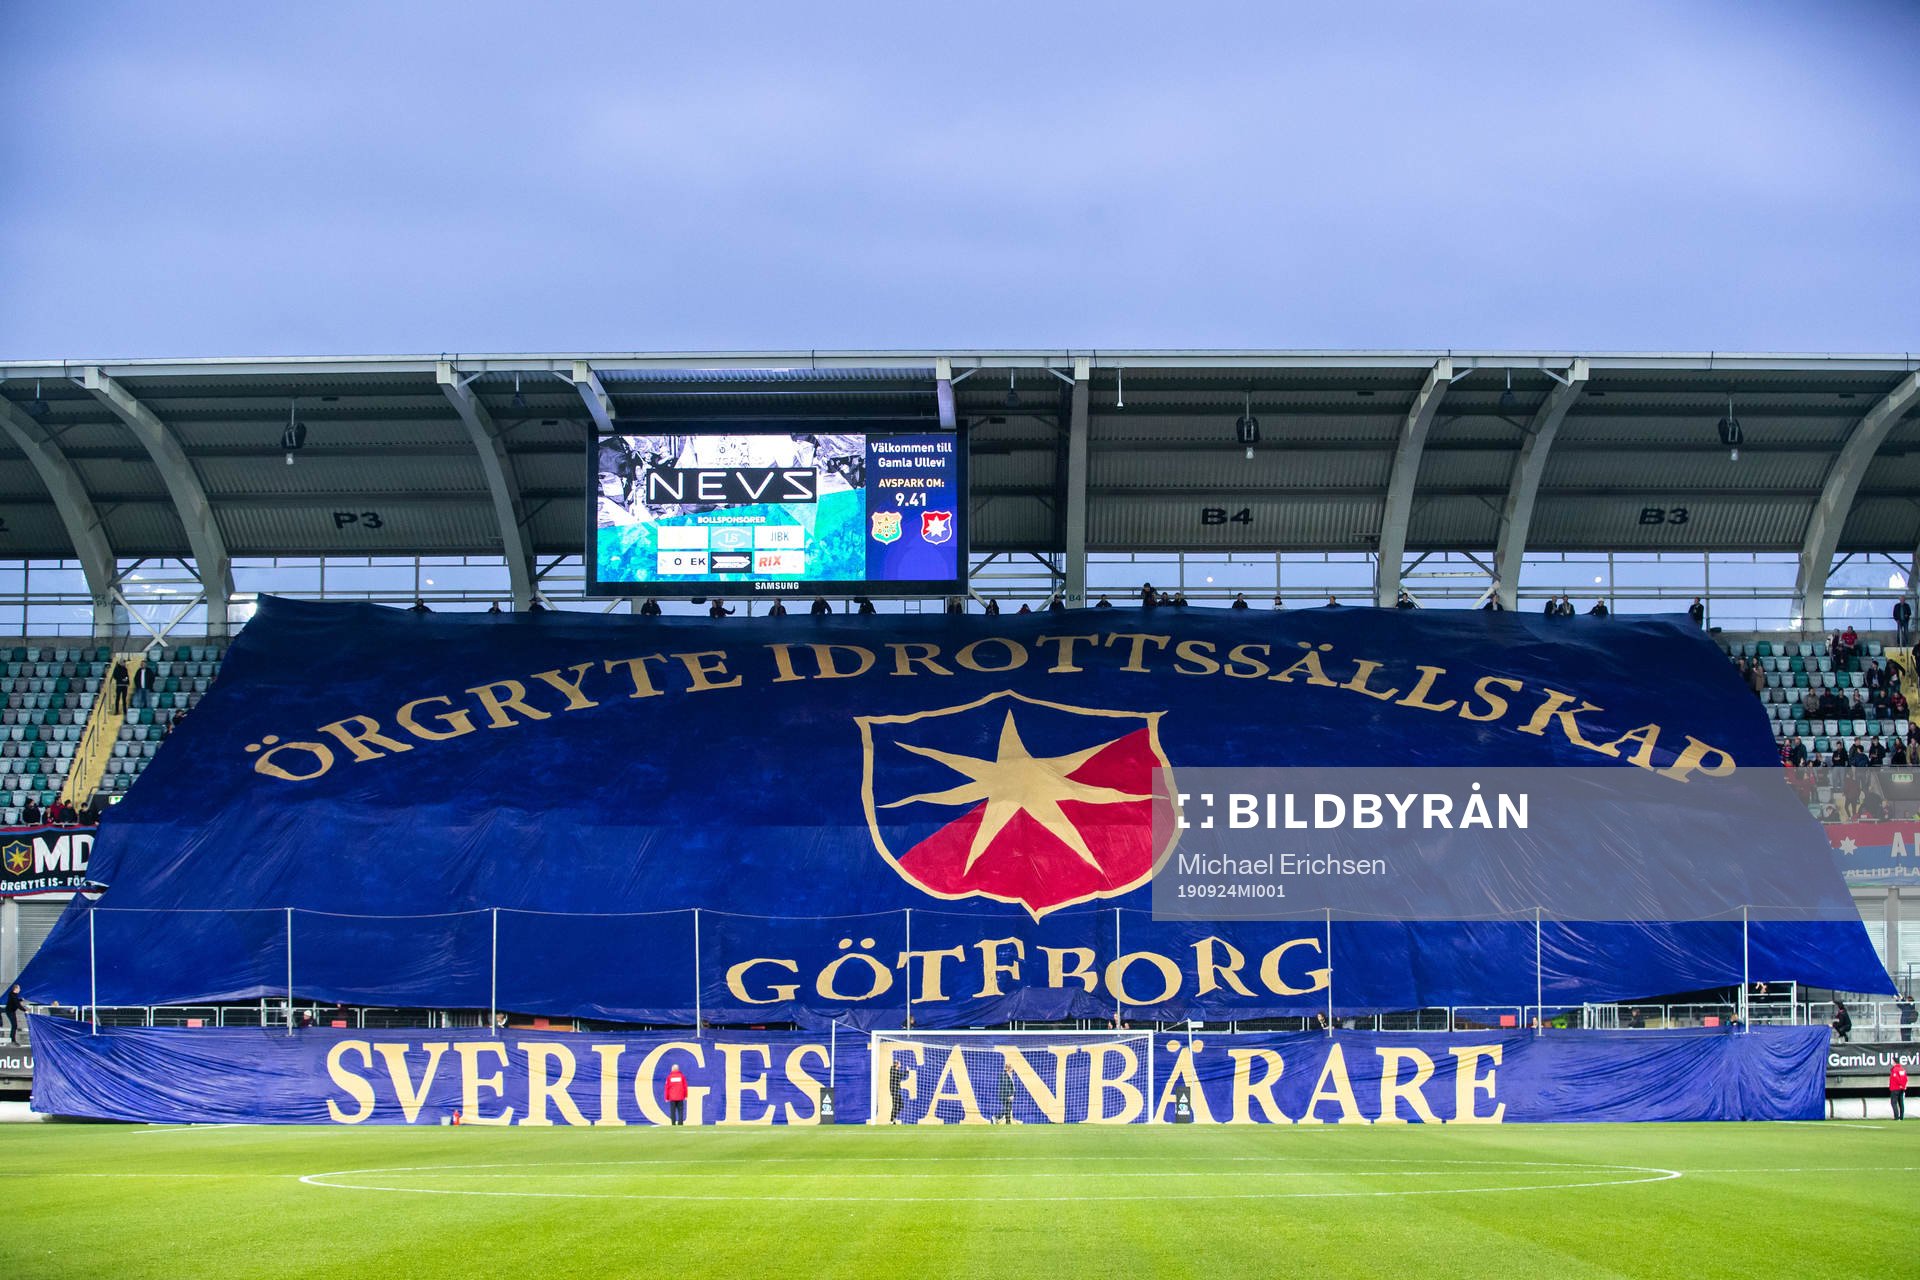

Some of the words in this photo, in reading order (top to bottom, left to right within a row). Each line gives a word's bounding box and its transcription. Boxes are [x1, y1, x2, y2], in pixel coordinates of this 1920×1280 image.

[871, 442, 934, 453] Välkommen
[936, 442, 953, 453] till
[878, 457, 912, 468] Gamla
[914, 457, 946, 468] Ullevi
[649, 472, 814, 501] NEVS
[878, 478, 924, 488] AVSPARK
[926, 478, 945, 488] OM:
[895, 492, 927, 507] 9.41
[333, 511, 383, 529] P3
[697, 516, 766, 525] BOLLSPONSORER
[1201, 508, 1253, 525] B4
[1639, 508, 1689, 525] B3
[759, 556, 781, 567] RIX
[755, 582, 800, 590] SAMSUNG
[244, 650, 743, 781] ÖRGRYTE
[763, 633, 1737, 783] IDROTTSSÄLLSKAP
[0, 878, 46, 892] ÖRGRYTE
[1828, 1053, 1875, 1067] Gamla
[326, 1040, 836, 1127] SVERIGES
[866, 1040, 1506, 1127] FANBÄRARE
